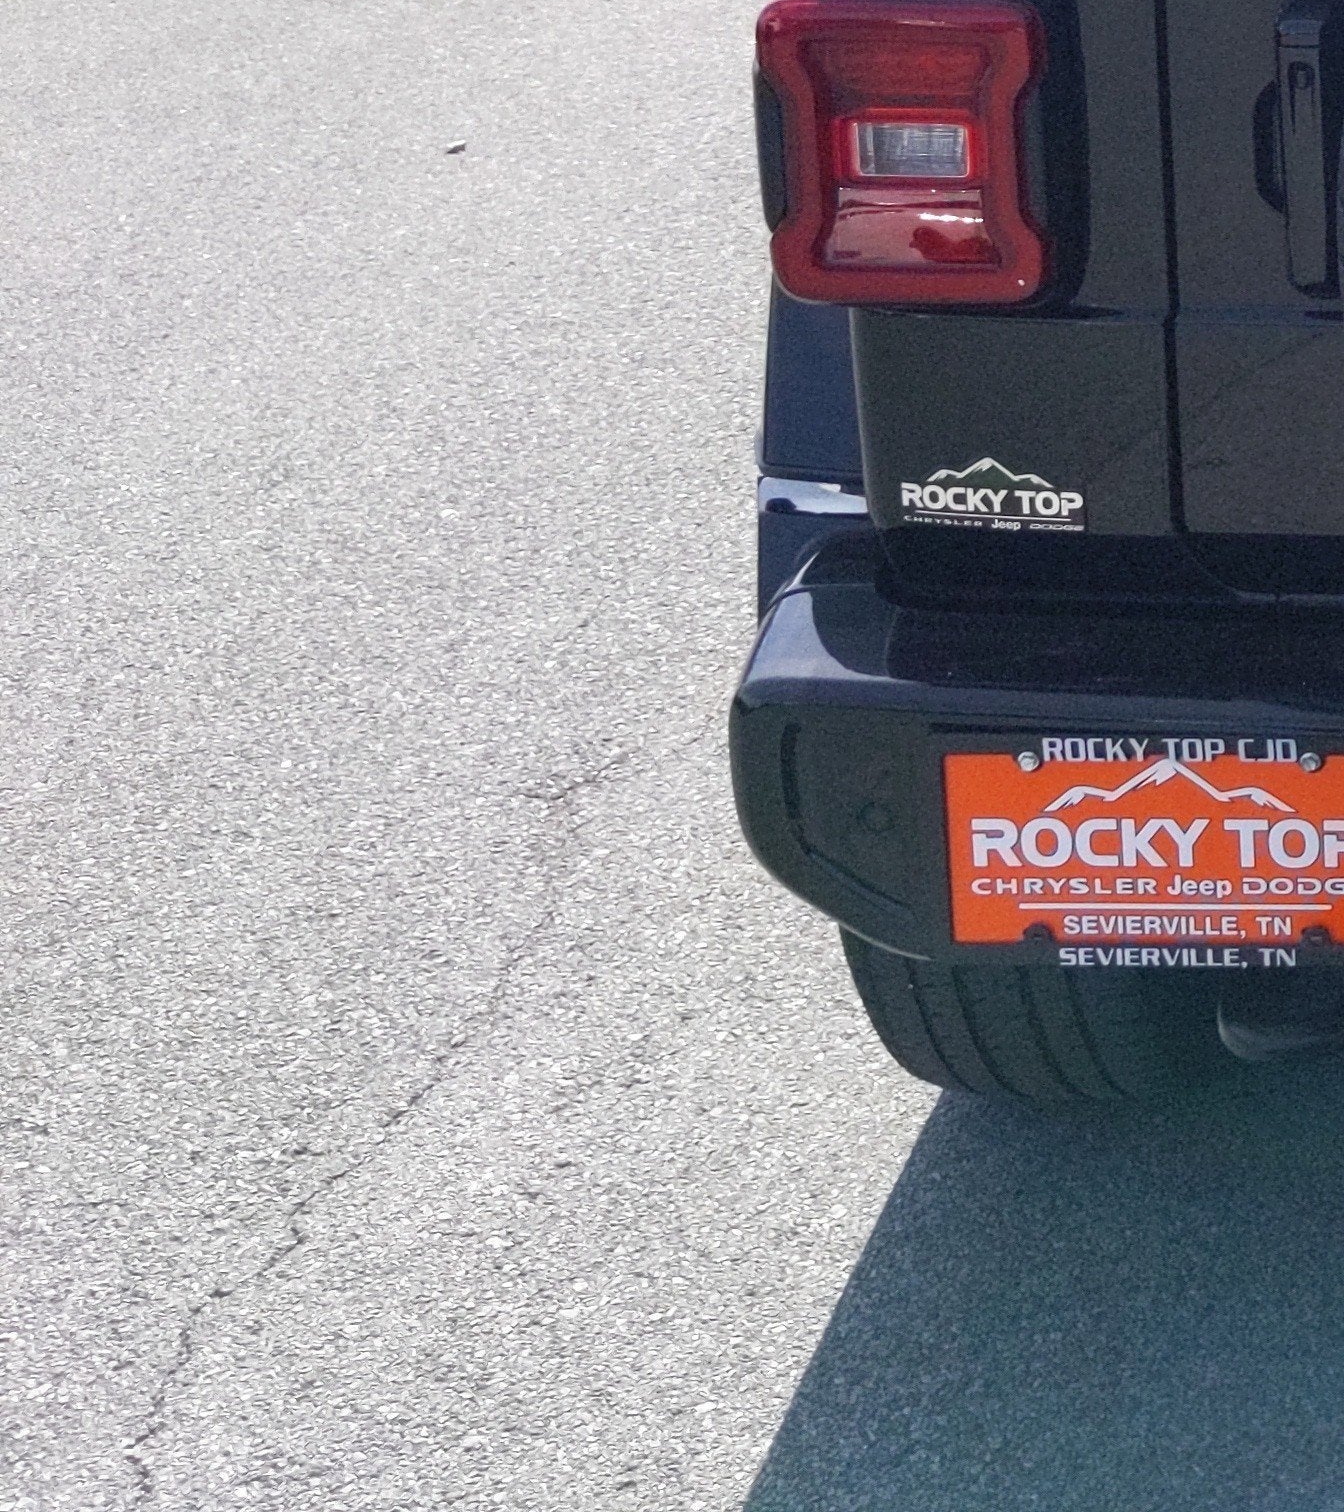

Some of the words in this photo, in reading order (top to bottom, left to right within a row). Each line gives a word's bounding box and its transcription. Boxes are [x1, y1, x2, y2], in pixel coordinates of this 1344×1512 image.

[901, 481, 1008, 513] ROCKY
[1014, 490, 1084, 516] TOP
[902, 515, 983, 527] CHRYSLER
[991, 518, 1021, 531] Jeep
[1029, 523, 1085, 531] DODGE
[1042, 737, 1149, 763] ROCKY
[1162, 738, 1225, 763] TOP
[1238, 738, 1298, 763] CJD
[970, 818, 1209, 868] ROCKY
[971, 877, 1157, 895] CHRYSLER
[1167, 874, 1233, 898] Jeep
[1063, 915, 1247, 940] SEVIERVILLE,
[1255, 916, 1293, 935] TN
[1058, 947, 1248, 969] SEVIERVILLE,
[1258, 948, 1297, 968] TN
